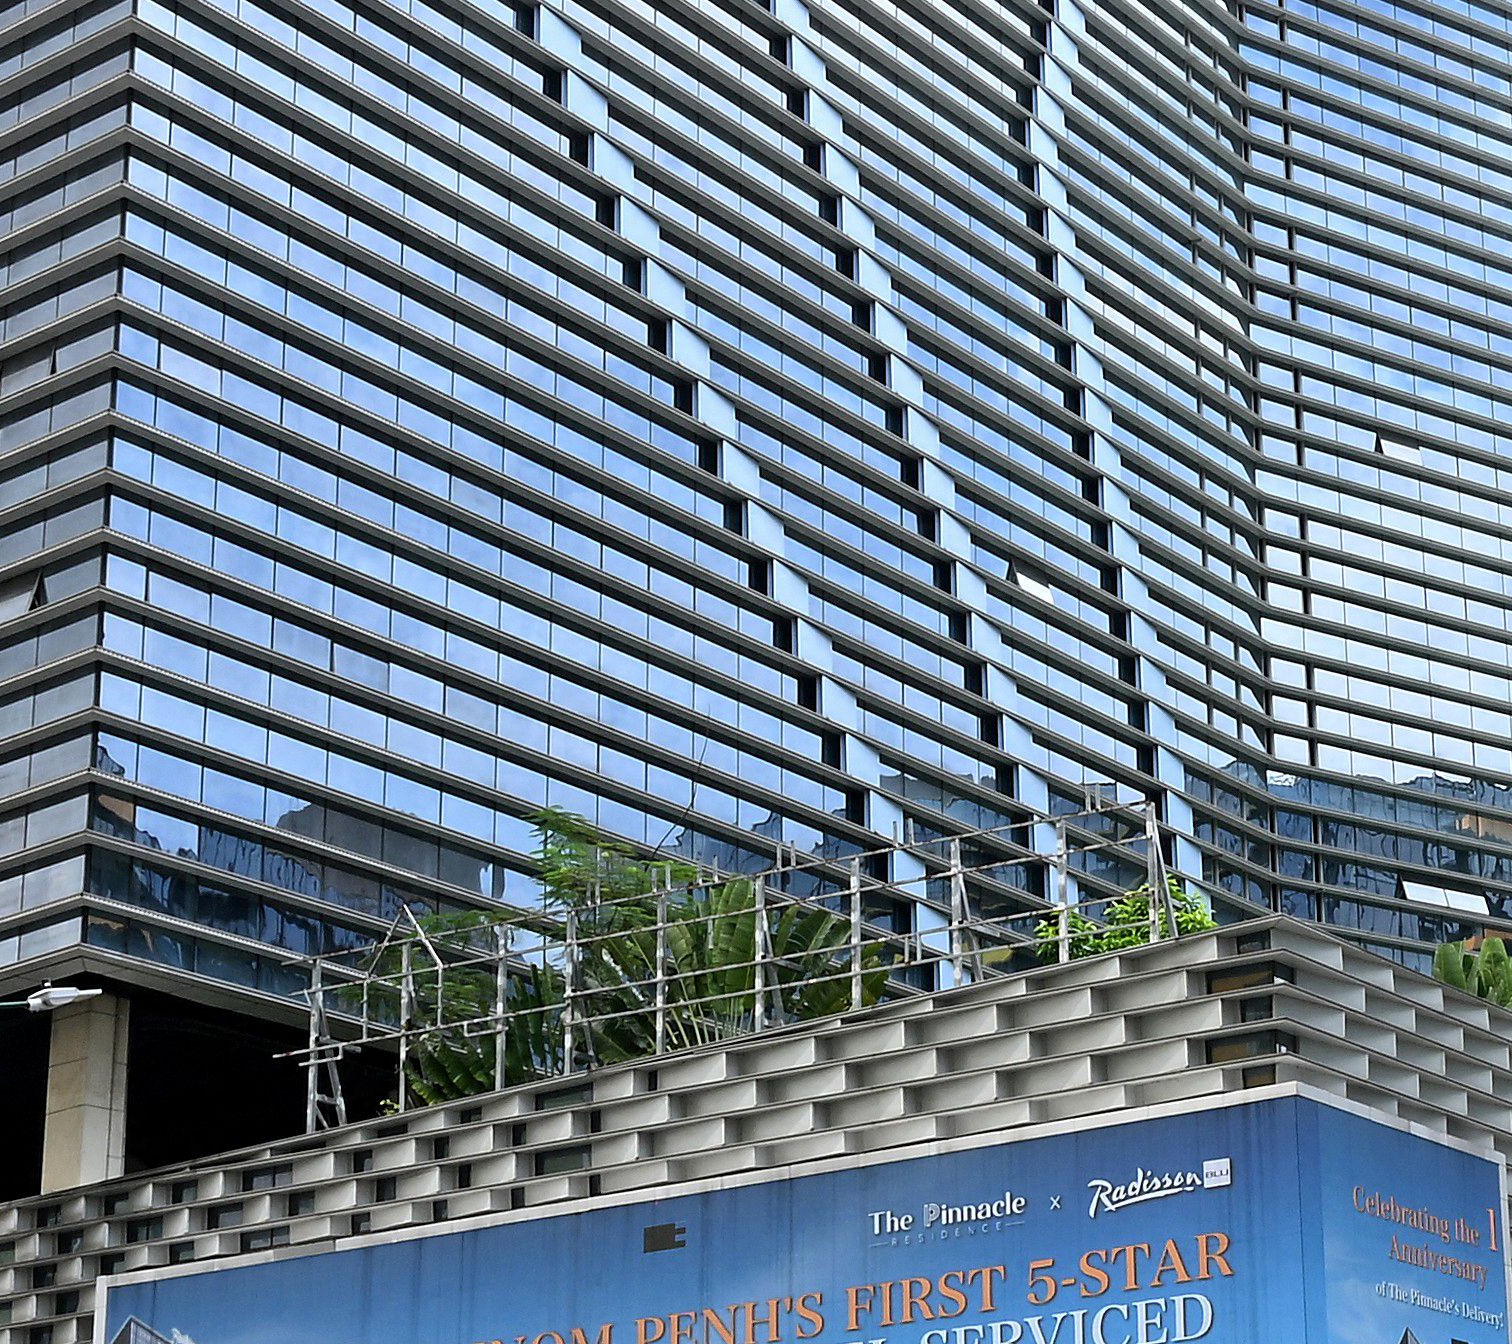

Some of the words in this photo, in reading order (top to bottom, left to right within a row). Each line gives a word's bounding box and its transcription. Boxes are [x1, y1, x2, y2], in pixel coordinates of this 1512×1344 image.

[868, 1210, 913, 1236] The
[923, 1191, 1027, 1229] Pinnacle
[1088, 1167, 1202, 1218] Radisson
[1352, 1185, 1451, 1244] Celebrating
[1454, 1218, 1480, 1249] the
[891, 1221, 1002, 1247] RESIDENCE
[1389, 1234, 1488, 1291] Anniversary
[845, 1265, 1007, 1332] FIRST
[1026, 1231, 1235, 1306] 5-STAR
[1375, 1280, 1387, 1297] of
[1388, 1282, 1408, 1303] The
[1410, 1288, 1459, 1316] Pinnacle's
[1461, 1302, 1504, 1331] Delivery!
